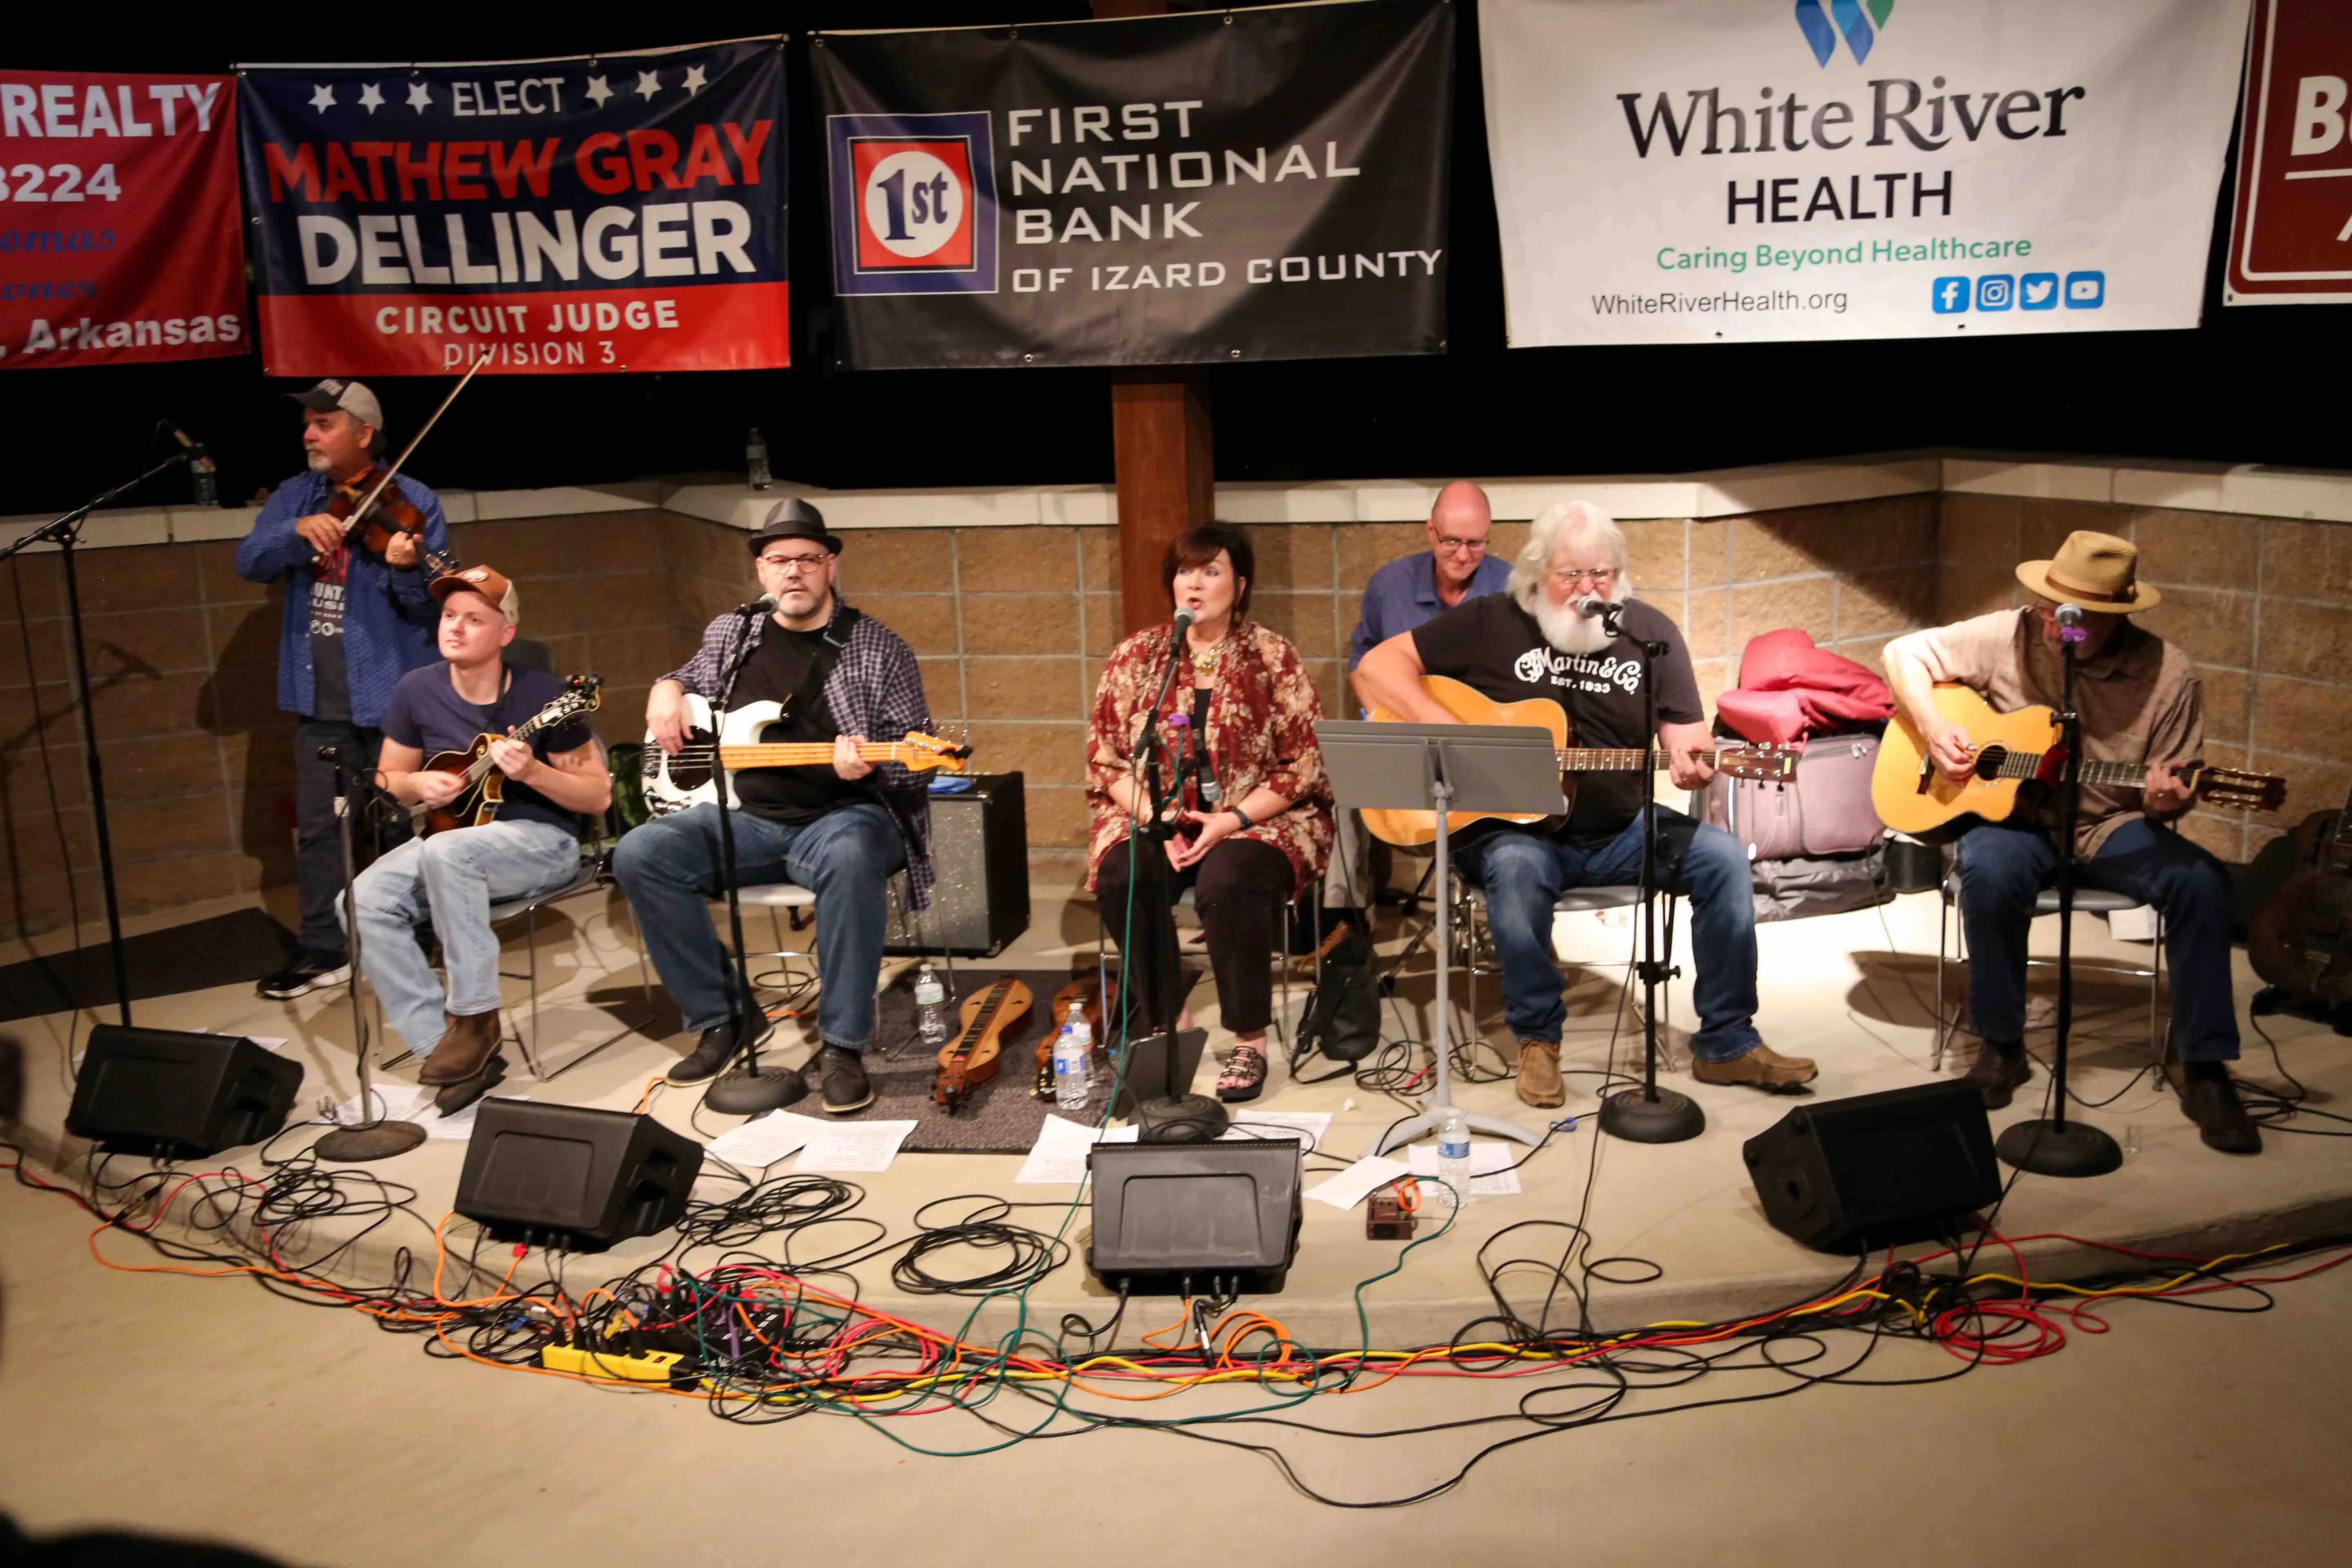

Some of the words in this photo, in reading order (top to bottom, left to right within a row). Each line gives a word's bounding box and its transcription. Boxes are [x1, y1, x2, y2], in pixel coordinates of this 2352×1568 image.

[0, 82, 222, 138] REALTY
[452, 78, 565, 116] ELECT
[1009, 100, 1203, 146] FIRST
[263, 138, 561, 202] MATHEW
[575, 119, 773, 195] GRAY
[1011, 141, 1361, 196] NATIONAL
[876, 168, 949, 242] 1st
[1726, 170, 1953, 225] HEALTH
[298, 200, 757, 285] DELLINGER
[1016, 201, 1203, 245] BANK
[1013, 267, 1074, 293] OF
[1091, 262, 1226, 291] IZARD
[1246, 249, 1442, 284] COUNTY
[1656, 246, 1748, 274] Caring
[1755, 241, 1863, 273] Beyond
[1871, 236, 2033, 264] Healthcare
[376, 305, 528, 334] CIRCUIT
[547, 299, 679, 332] JUDGE
[1592, 288, 1847, 315] WhiteRiverHealth.org
[22, 315, 240, 354] Arkansas
[444, 341, 585, 366] DIVISION
[598, 340, 616, 364] 3
[311, 582, 345, 601] UNT
